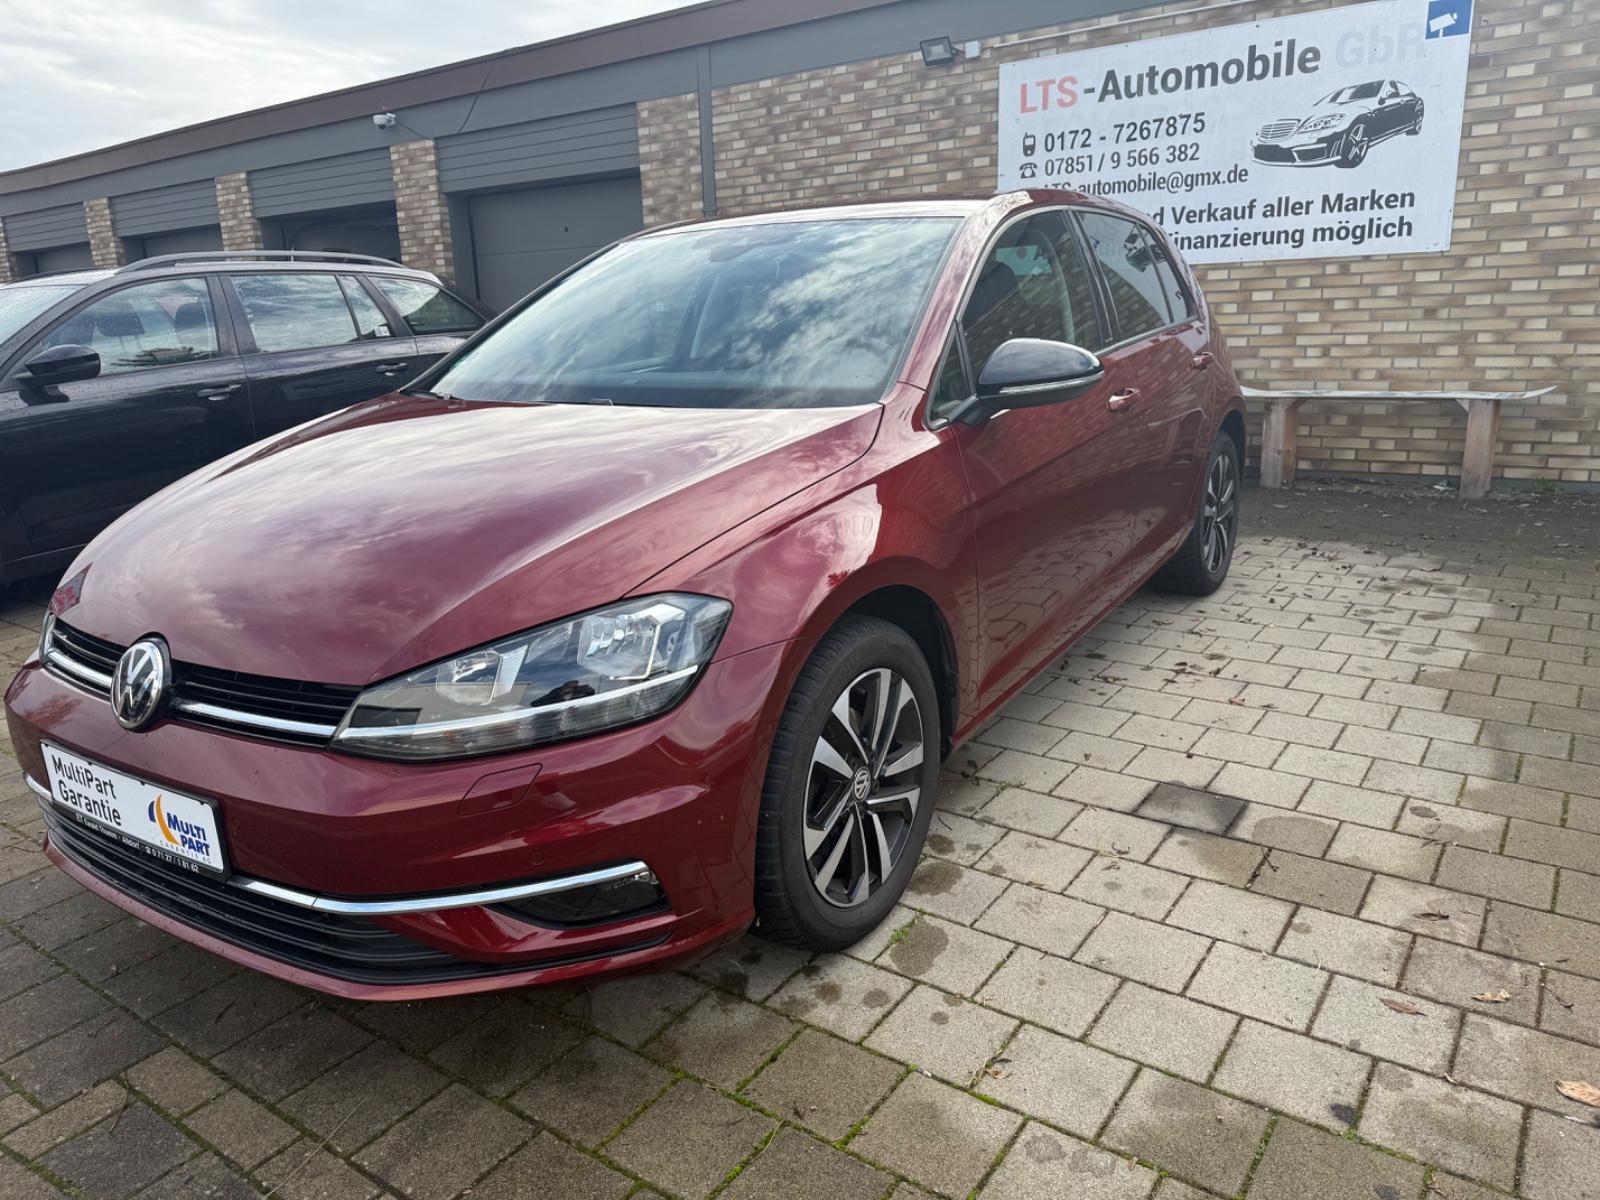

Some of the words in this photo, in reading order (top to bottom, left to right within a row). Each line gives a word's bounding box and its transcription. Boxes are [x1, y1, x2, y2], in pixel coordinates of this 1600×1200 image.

[1044, 128, 1092, 152] 0172
[1113, 111, 1206, 144] 7267875
[1044, 154, 1093, 177] 07851
[1111, 151, 1121, 169] 9
[1127, 147, 1160, 167] 566
[1166, 142, 1200, 163] 382
[1044, 163, 1249, 196] -automobile@gmx.de
[1170, 198, 1257, 225] Verkauf
[1262, 196, 1314, 218] aller
[1320, 189, 1415, 214] Marken
[1168, 226, 1305, 251] inanzierung
[1312, 215, 1413, 245] möglich
[51, 754, 117, 800] MultiPart
[58, 779, 122, 826] Garantie
[166, 811, 207, 842] MULTI
[180, 834, 210, 857] PART
